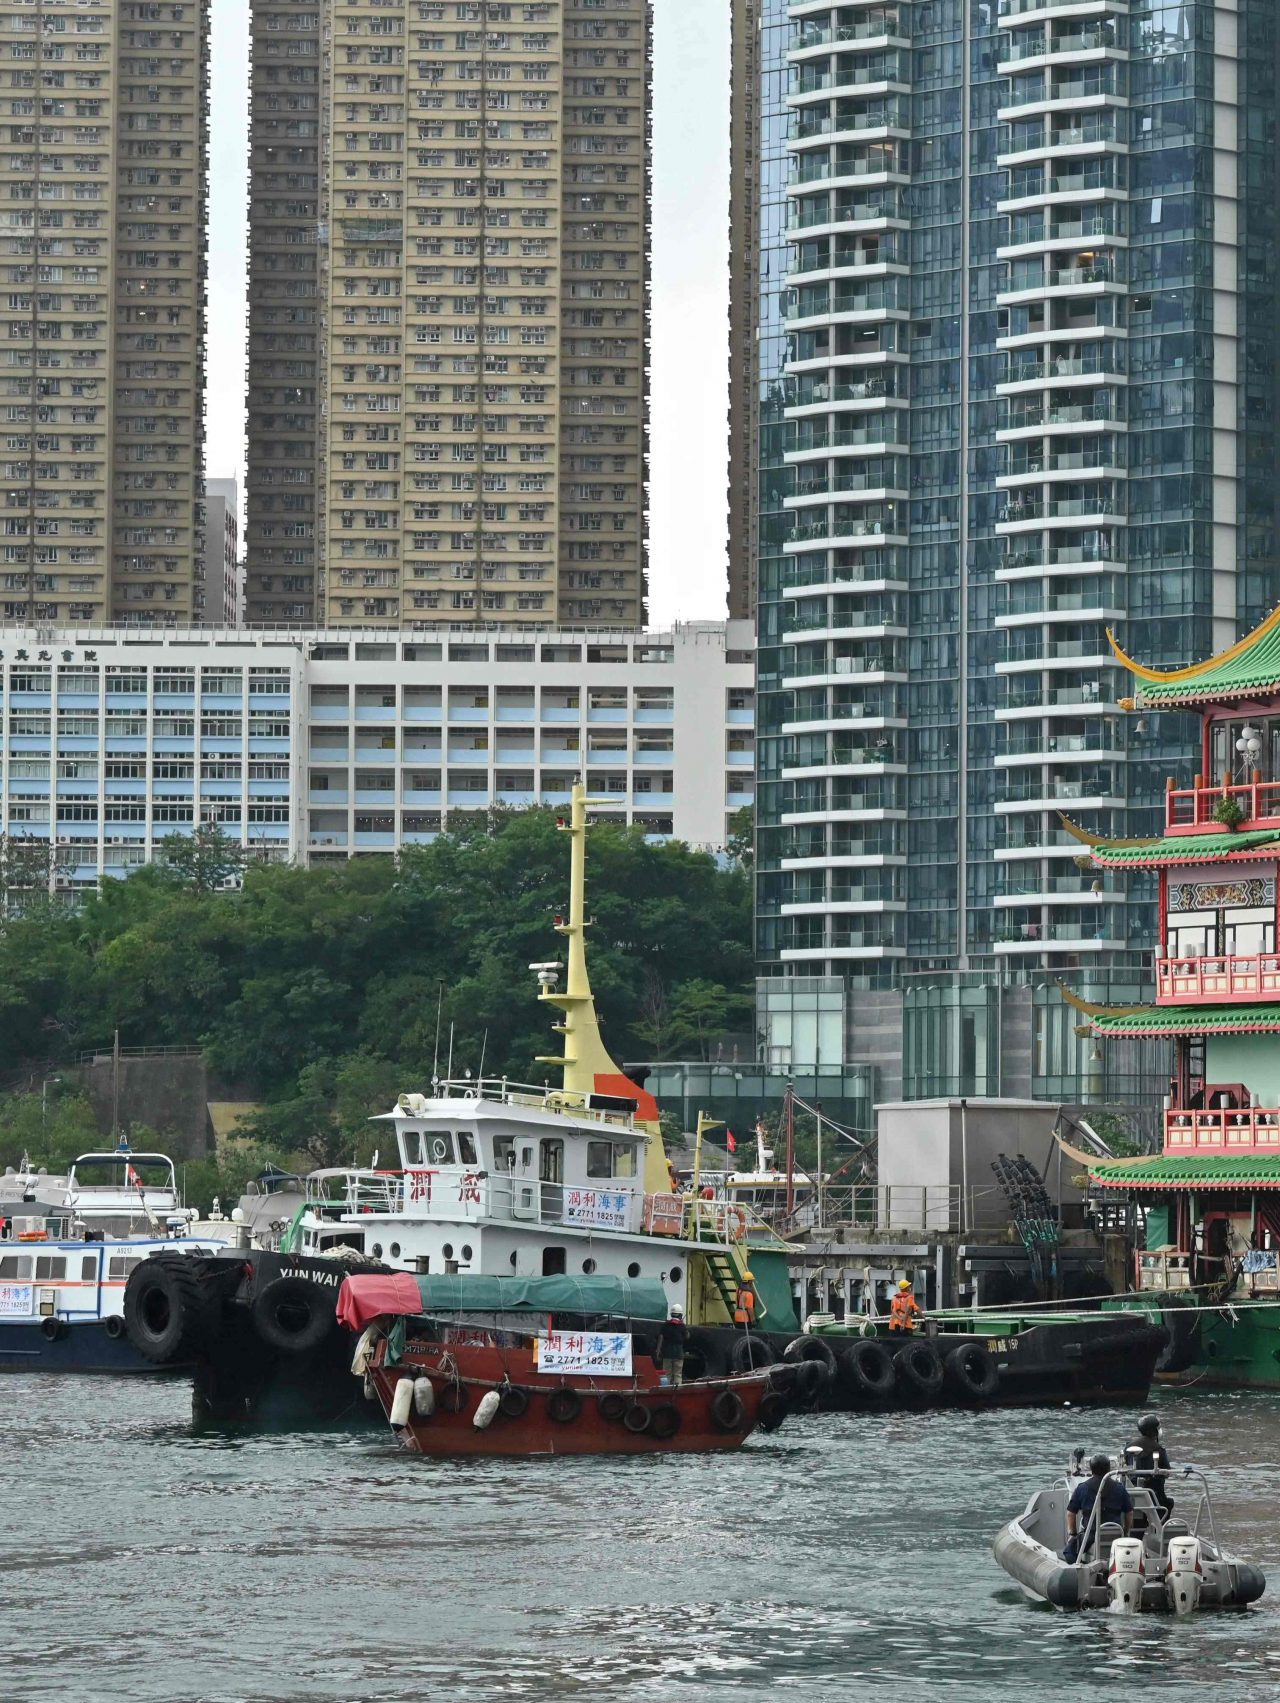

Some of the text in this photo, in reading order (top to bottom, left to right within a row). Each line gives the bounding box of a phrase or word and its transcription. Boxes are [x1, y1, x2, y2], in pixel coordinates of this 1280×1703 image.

[568, 1191, 627, 1212] 潤利海事
[577, 1209, 614, 1221] 2771 1825
[312, 1270, 339, 1287] WAI
[544, 1335, 627, 1355] 潤利海事
[557, 1356, 609, 1366] 2771 1825
